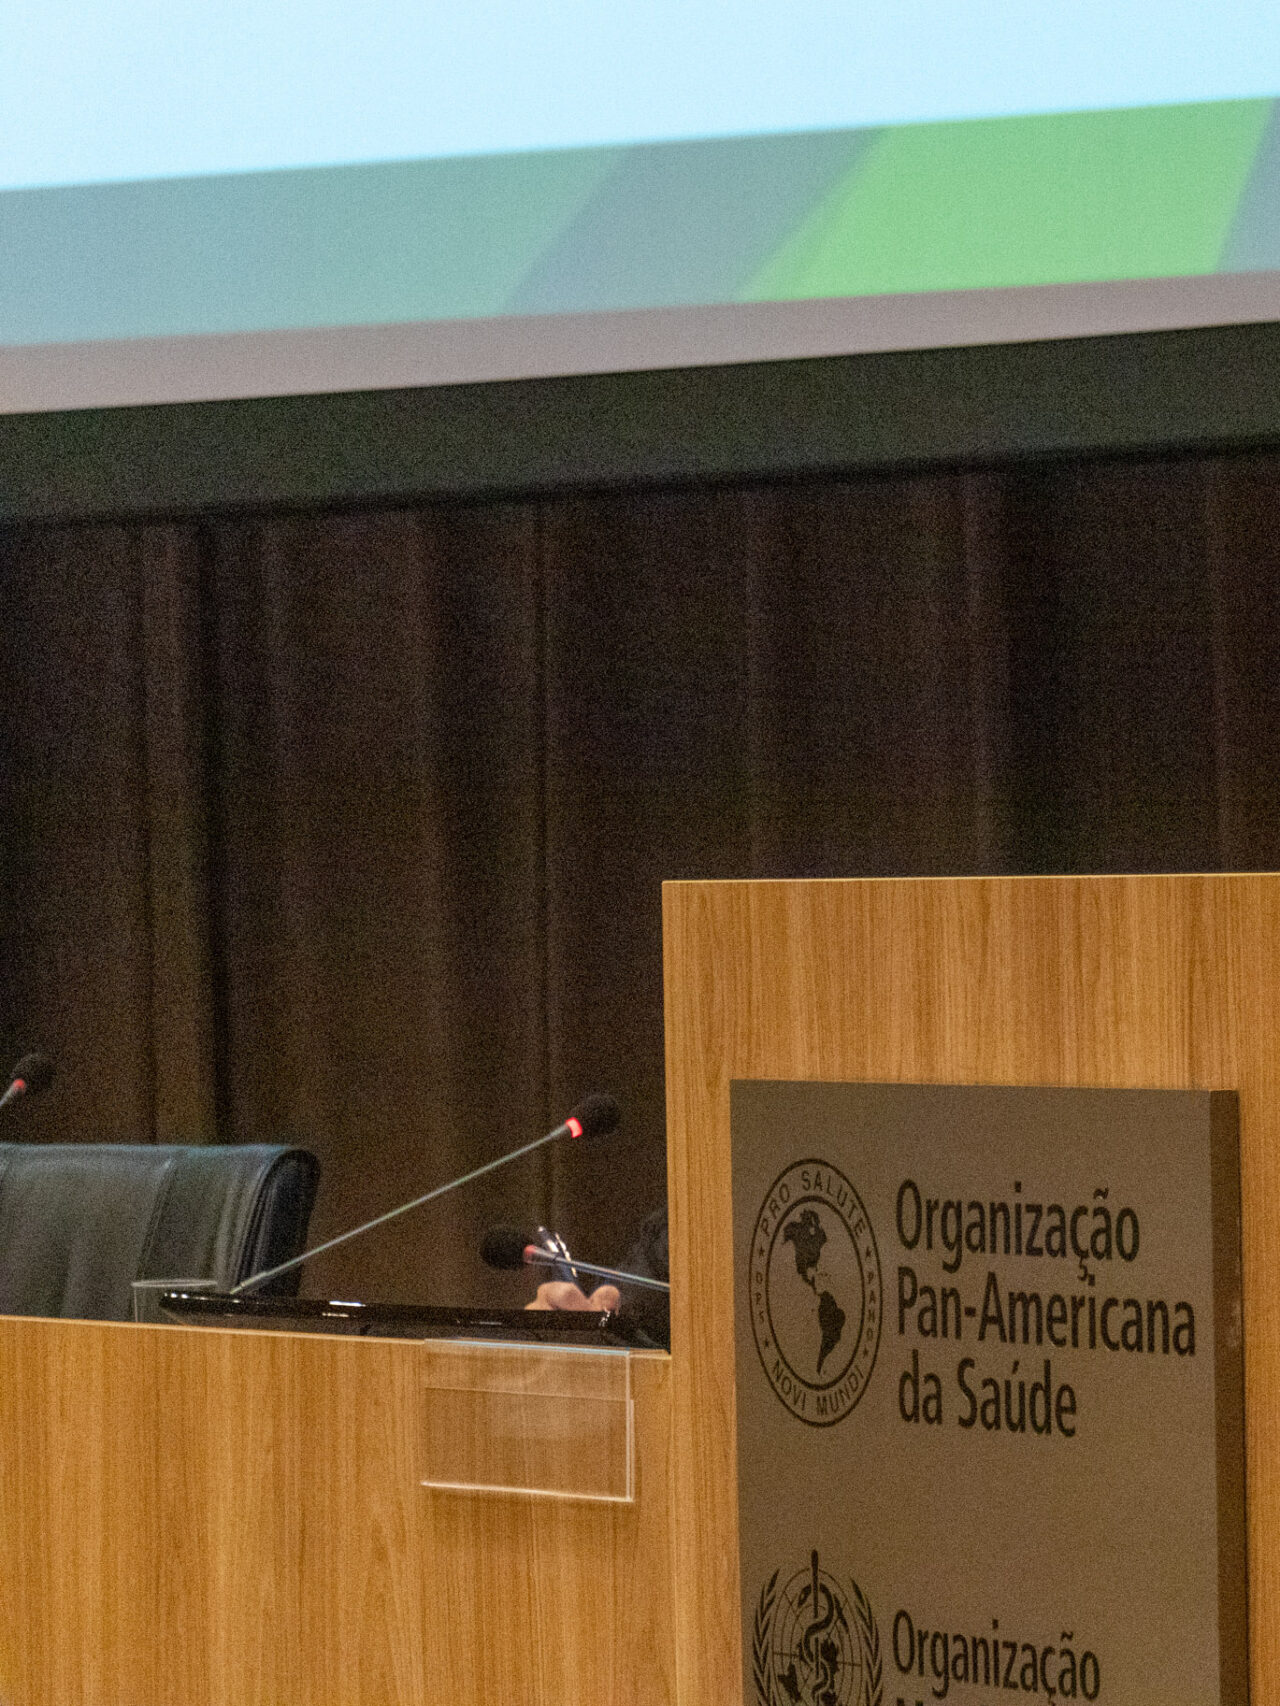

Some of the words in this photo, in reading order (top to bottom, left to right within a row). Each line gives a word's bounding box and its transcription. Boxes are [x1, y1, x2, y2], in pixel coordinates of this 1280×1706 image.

[760, 1183, 791, 1237] PRO
[801, 1170, 866, 1238] SALUTE
[895, 1178, 1140, 1282] Organização
[897, 1266, 1196, 1357] Pan-Americana
[772, 1359, 807, 1412] NOVI
[816, 1364, 865, 1416] MUNDI
[899, 1349, 943, 1425] da
[957, 1357, 1077, 1438] Saúde
[892, 1609, 1100, 1706] Organização
